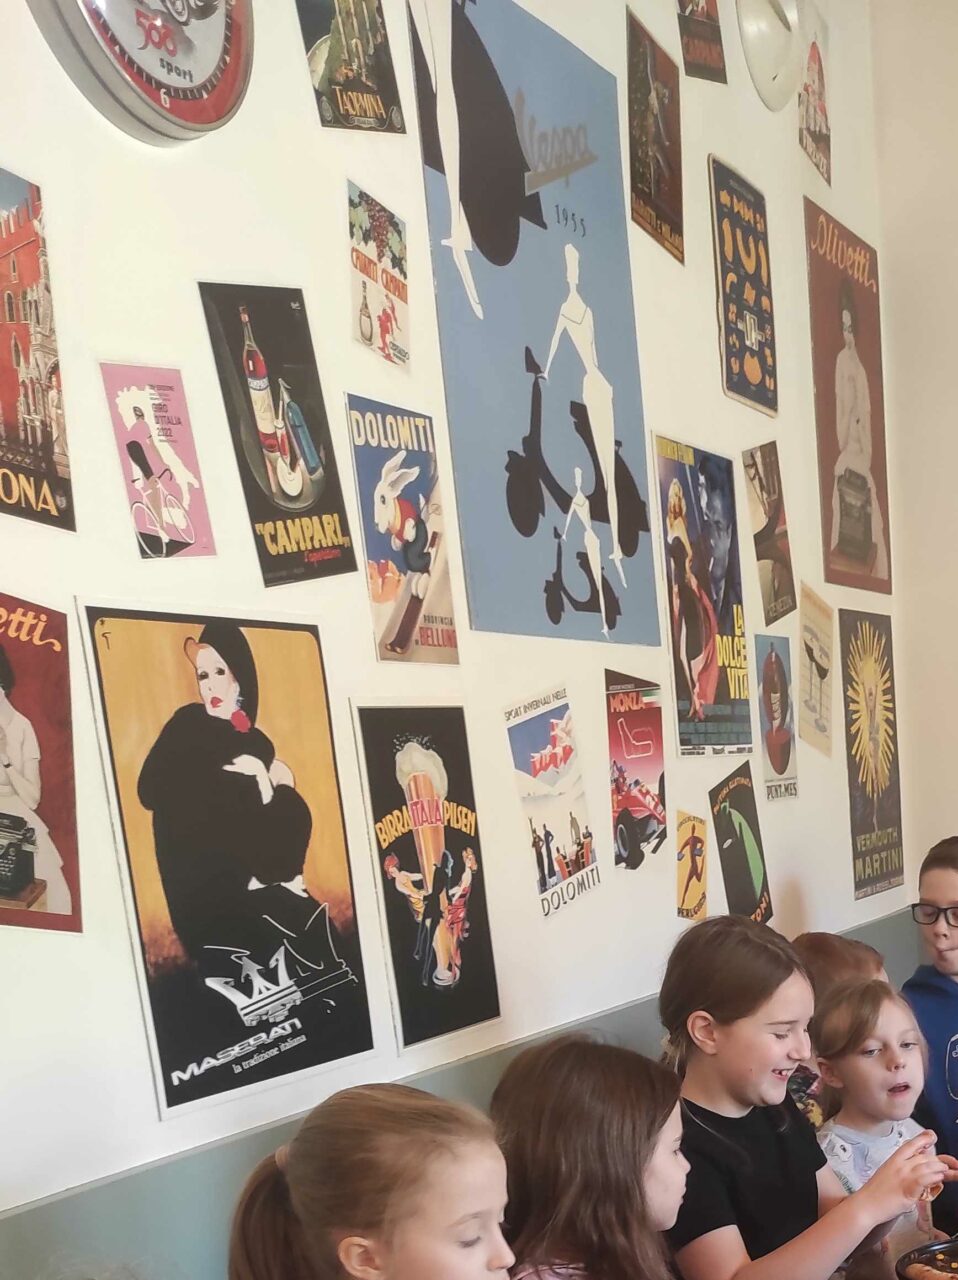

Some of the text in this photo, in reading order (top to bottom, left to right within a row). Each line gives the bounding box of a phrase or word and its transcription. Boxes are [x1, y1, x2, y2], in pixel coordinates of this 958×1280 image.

[159, 57, 194, 84] sport
[160, 88, 171, 109] 6
[331, 85, 388, 119] TAORMINA
[554, 203, 587, 239] 1955
[811, 214, 877, 294] Olivetti
[349, 410, 435, 453] DOLOMITI
[733, 604, 746, 635] LA
[715, 633, 748, 668] DOLCE
[727, 667, 750, 699] VITA
[609, 691, 646, 713] MONZA
[375, 804, 412, 850] BIRRA
[442, 799, 476, 837] PILSEN
[856, 846, 903, 882] MARTINI
[541, 865, 601, 917] DOLOMITI
[171, 1017, 302, 1086] MASERATI
